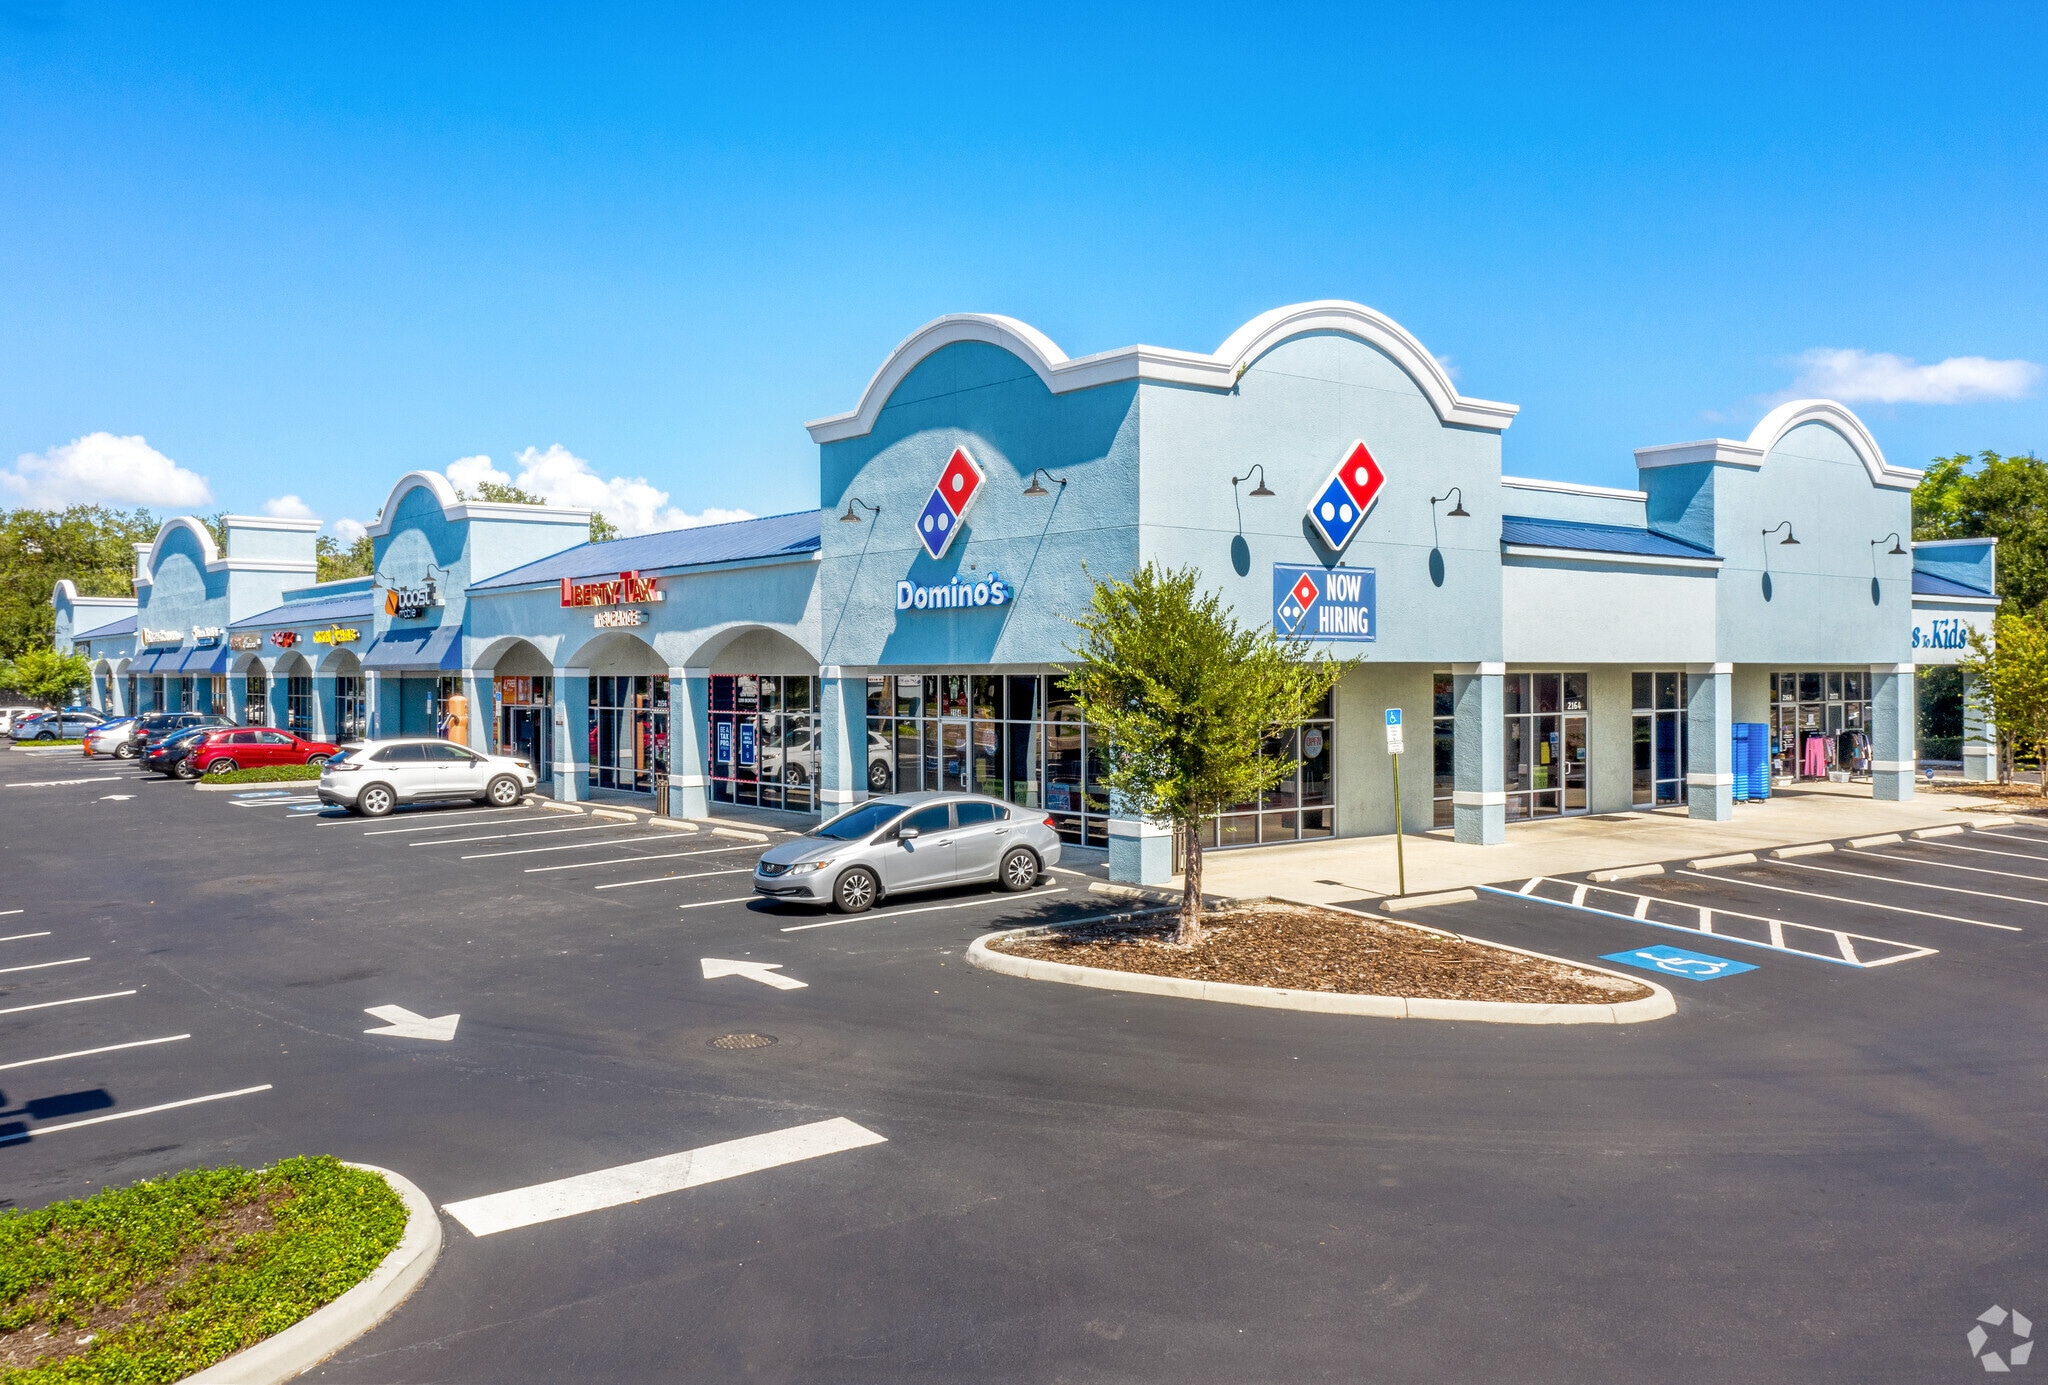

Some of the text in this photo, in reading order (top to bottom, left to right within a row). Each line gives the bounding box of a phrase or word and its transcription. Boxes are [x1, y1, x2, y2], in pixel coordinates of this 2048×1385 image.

[398, 587, 431, 608] boost
[561, 570, 659, 609] LIBERTY TAX
[896, 571, 1009, 610] Domino's
[1326, 573, 1362, 602] NOW
[398, 608, 417, 619] mobile
[1319, 605, 1369, 634] HIRING
[1930, 618, 1967, 649] Kids
[1567, 701, 1582, 710] 2164
[1305, 735, 1321, 747] OPEN
